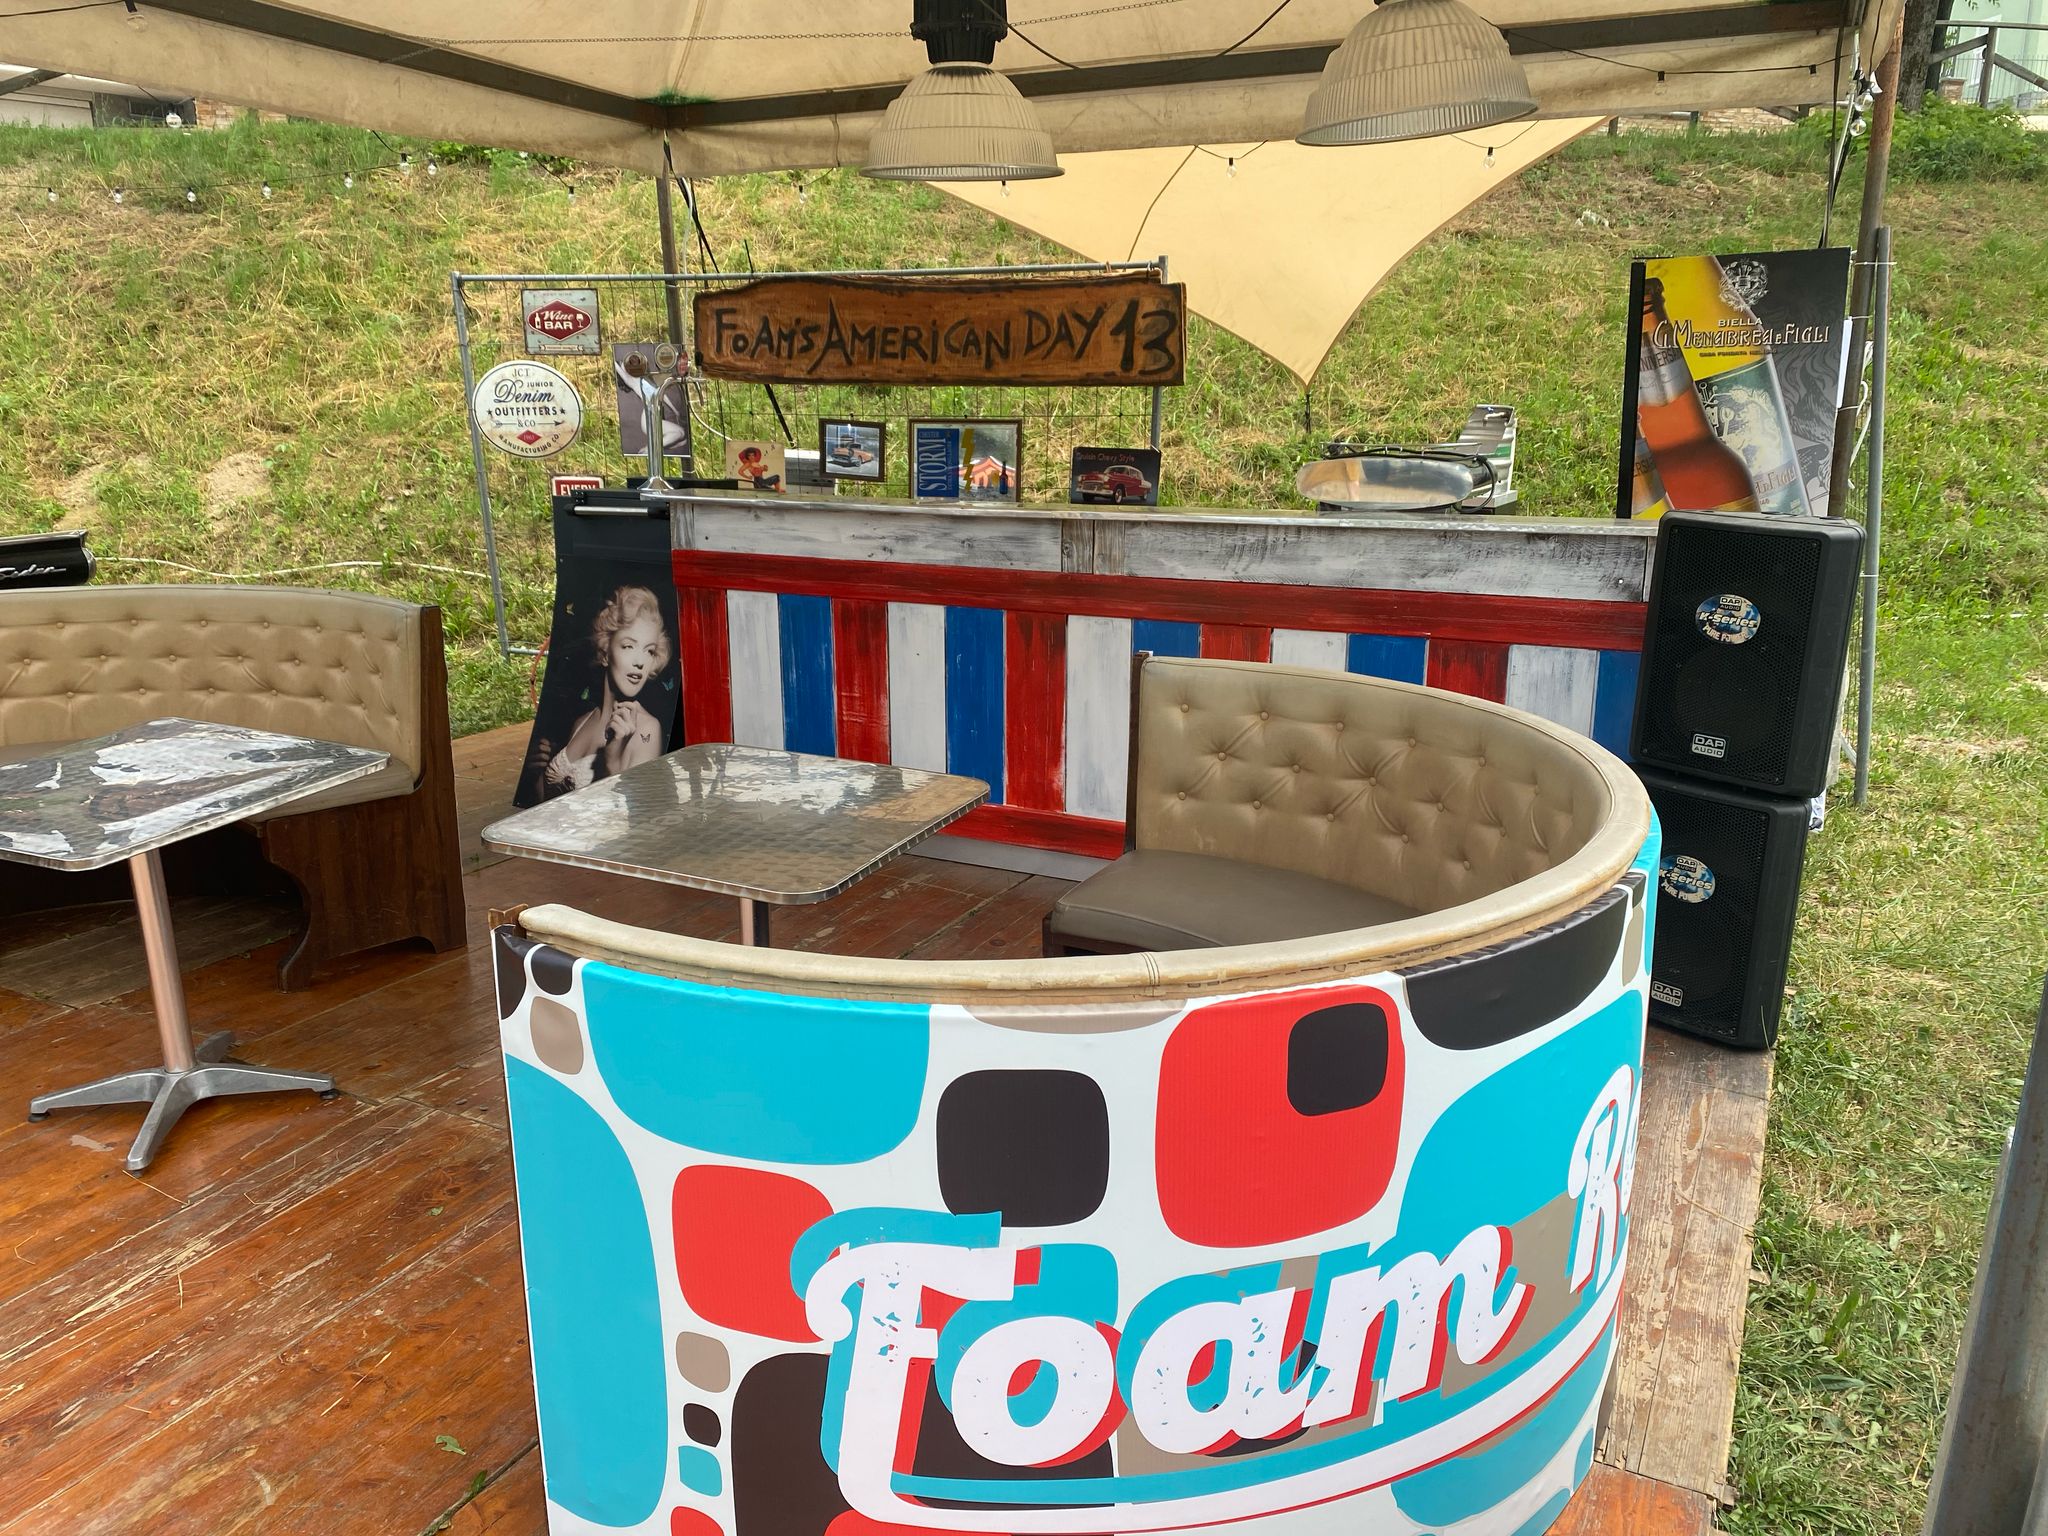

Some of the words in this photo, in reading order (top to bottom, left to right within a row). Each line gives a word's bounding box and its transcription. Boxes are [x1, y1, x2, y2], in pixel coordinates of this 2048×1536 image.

[541, 310, 574, 320] Wine
[1717, 317, 1763, 328] BIELLA
[544, 321, 573, 330] BAR
[807, 297, 1011, 375] AMERICAN
[1024, 308, 1104, 360] DAY
[1110, 299, 1179, 376] 13
[493, 378, 555, 403] Denim
[494, 406, 558, 416] OUTFITTERS
[498, 434, 552, 454] MANUFACTURING
[918, 438, 948, 491] STORM
[1699, 611, 1758, 628] K-Series
[1702, 623, 1719, 640] PURE
[1695, 736, 1724, 748] DAP
[1694, 745, 1723, 756] AUDIO
[1659, 869, 1712, 890] K-Series
[1654, 983, 1681, 997] DAP
[1653, 992, 1680, 1005] AUDIO
[803, 1224, 1530, 1528] Foam
[1566, 1063, 1643, 1294] R
